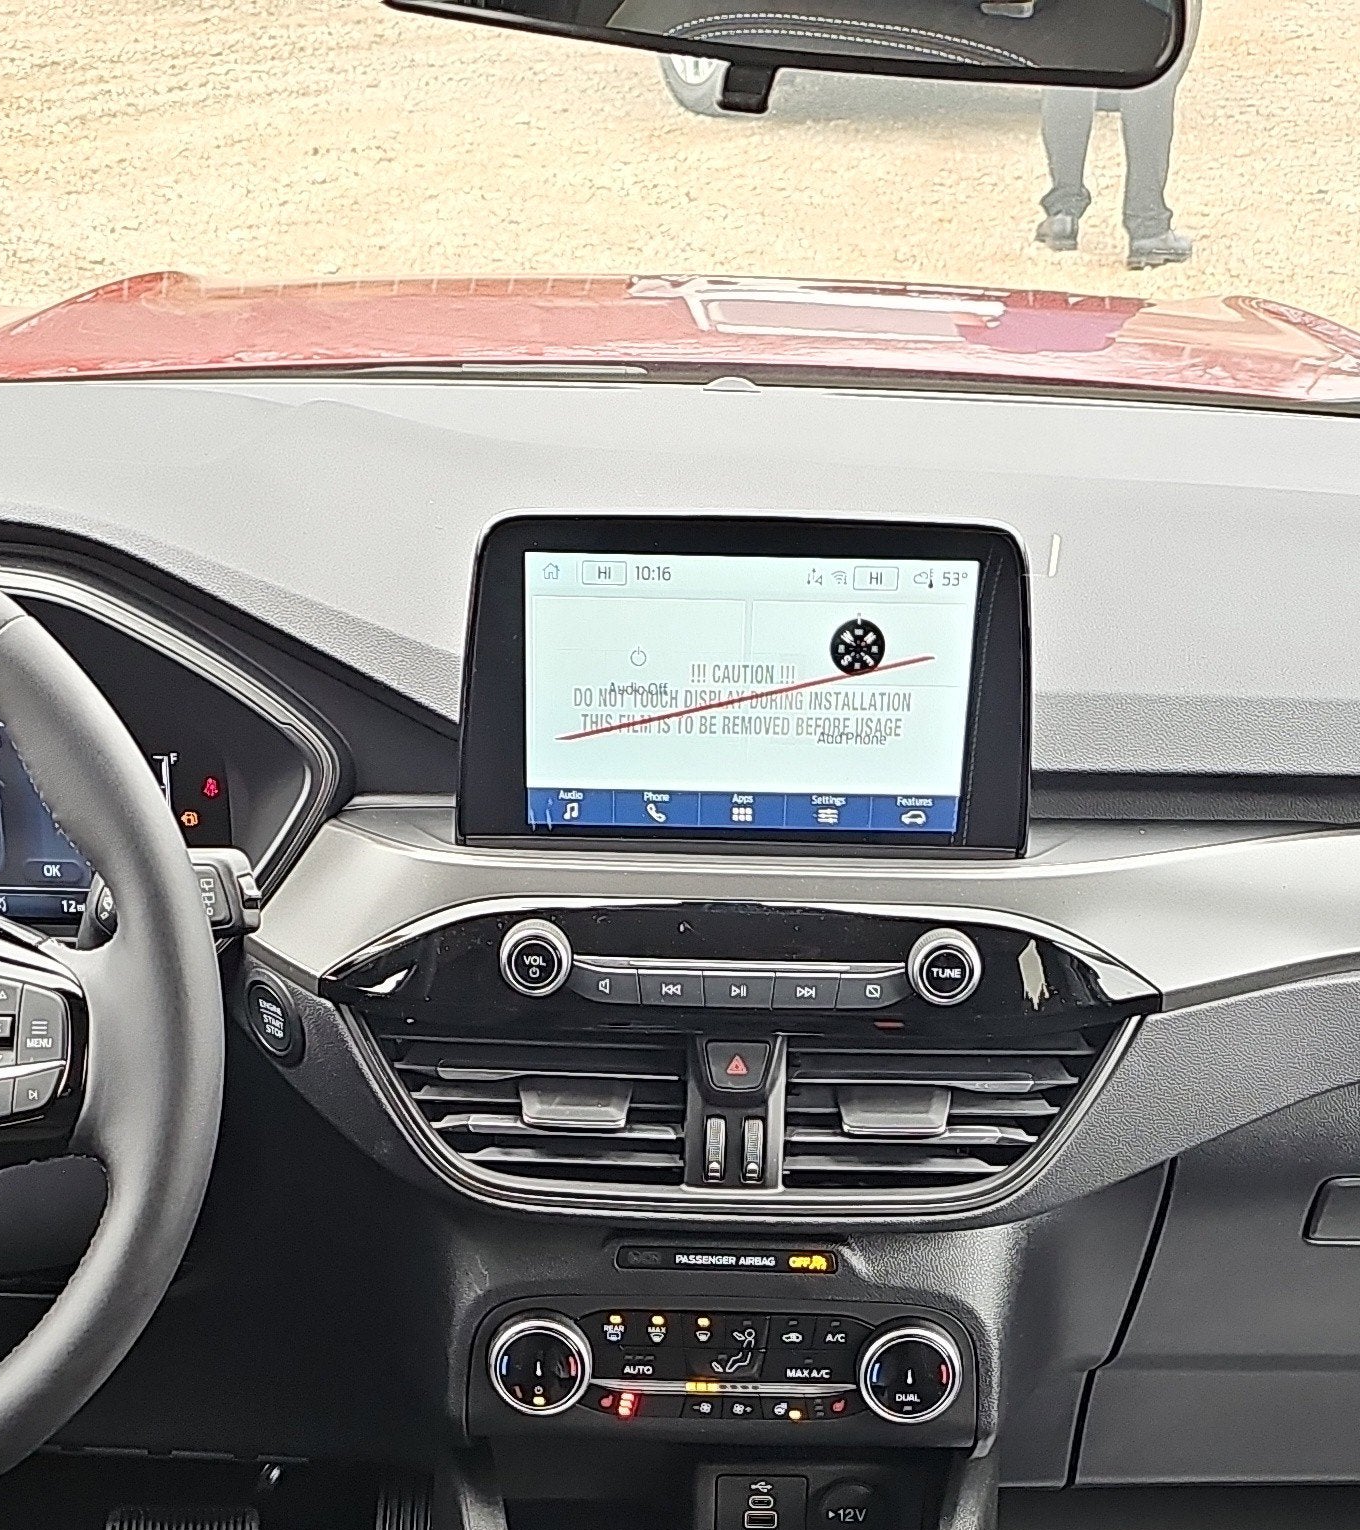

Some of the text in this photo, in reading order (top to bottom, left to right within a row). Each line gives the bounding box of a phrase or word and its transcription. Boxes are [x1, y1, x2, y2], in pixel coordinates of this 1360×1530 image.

[597, 566, 611, 579] HI
[635, 566, 671, 581] 10:16
[869, 572, 883, 585] HI
[942, 571, 968, 587] 53°
[712, 664, 774, 684] CAUTION
[609, 681, 669, 696] Audio Off
[573, 687, 912, 712] DO NOT TOUCH DISPLAY DURING INSTALLATION
[581, 713, 903, 737] THIS FILM IS TO BE REMOVED BEFORE USAGE
[817, 731, 887, 746] Add Phone
[170, 752, 178, 764] F
[557, 790, 583, 800] Audio
[643, 791, 670, 802] Phone
[731, 794, 754, 805] Apps
[811, 795, 846, 807] Settings
[896, 796, 933, 807] Features
[43, 864, 61, 877] OK
[61, 899, 76, 913] 12
[522, 954, 546, 967] VOL
[931, 968, 962, 980] TUNE
[262, 1014, 284, 1030] START
[265, 1024, 284, 1039] STOP
[26, 1038, 53, 1048] MENU
[675, 1254, 735, 1266] PASSENGER
[738, 1256, 776, 1267] AIRBAG
[788, 1256, 810, 1269] OFF
[603, 1324, 625, 1333] REAR
[648, 1326, 666, 1334] MAX
[825, 1333, 846, 1343] A/C
[623, 1365, 653, 1375] AUTO
[786, 1368, 831, 1379] MAX A/C
[895, 1393, 920, 1403] DUAL
[837, 1507, 867, 1523] 12V
